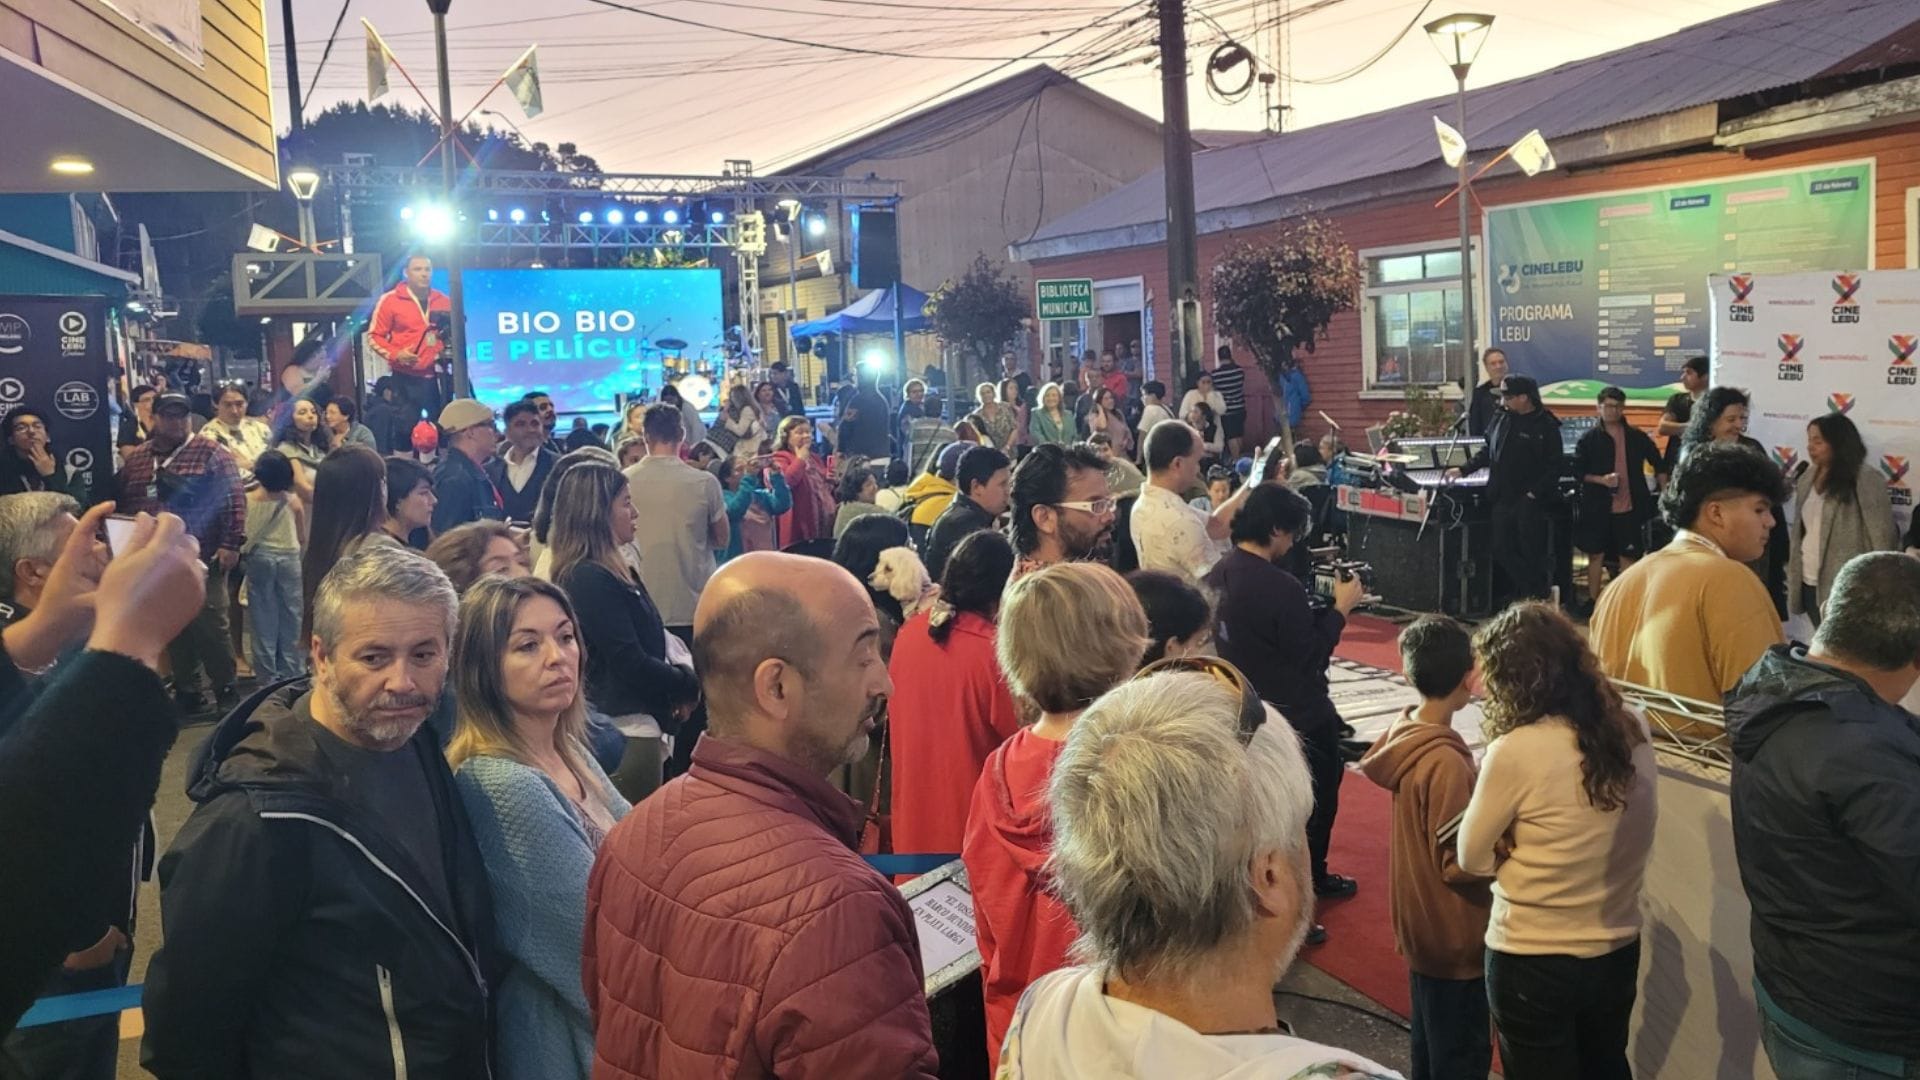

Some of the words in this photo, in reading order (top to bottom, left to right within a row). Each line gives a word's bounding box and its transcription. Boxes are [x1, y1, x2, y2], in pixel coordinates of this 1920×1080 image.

[1521, 259, 1584, 276] CINELEBU
[1040, 284, 1090, 299] BIBLIOTECA
[1042, 301, 1089, 315] MUNICIPAL
[1500, 303, 1574, 322] PROGRAMA
[1729, 305, 1754, 314] CINE
[1831, 305, 1861, 315] CINE
[498, 311, 561, 334] BIO
[575, 309, 636, 333] BIO
[1729, 314, 1755, 322] LEBU
[1831, 315, 1860, 324] LEBU
[1500, 325, 1531, 342] LEBU
[467, 340, 494, 362] E
[1778, 363, 1804, 372] CINE
[1887, 366, 1917, 376] CINE
[1778, 372, 1804, 381] LEBU
[1887, 376, 1917, 386] LEBU
[63, 392, 90, 403] LAB
